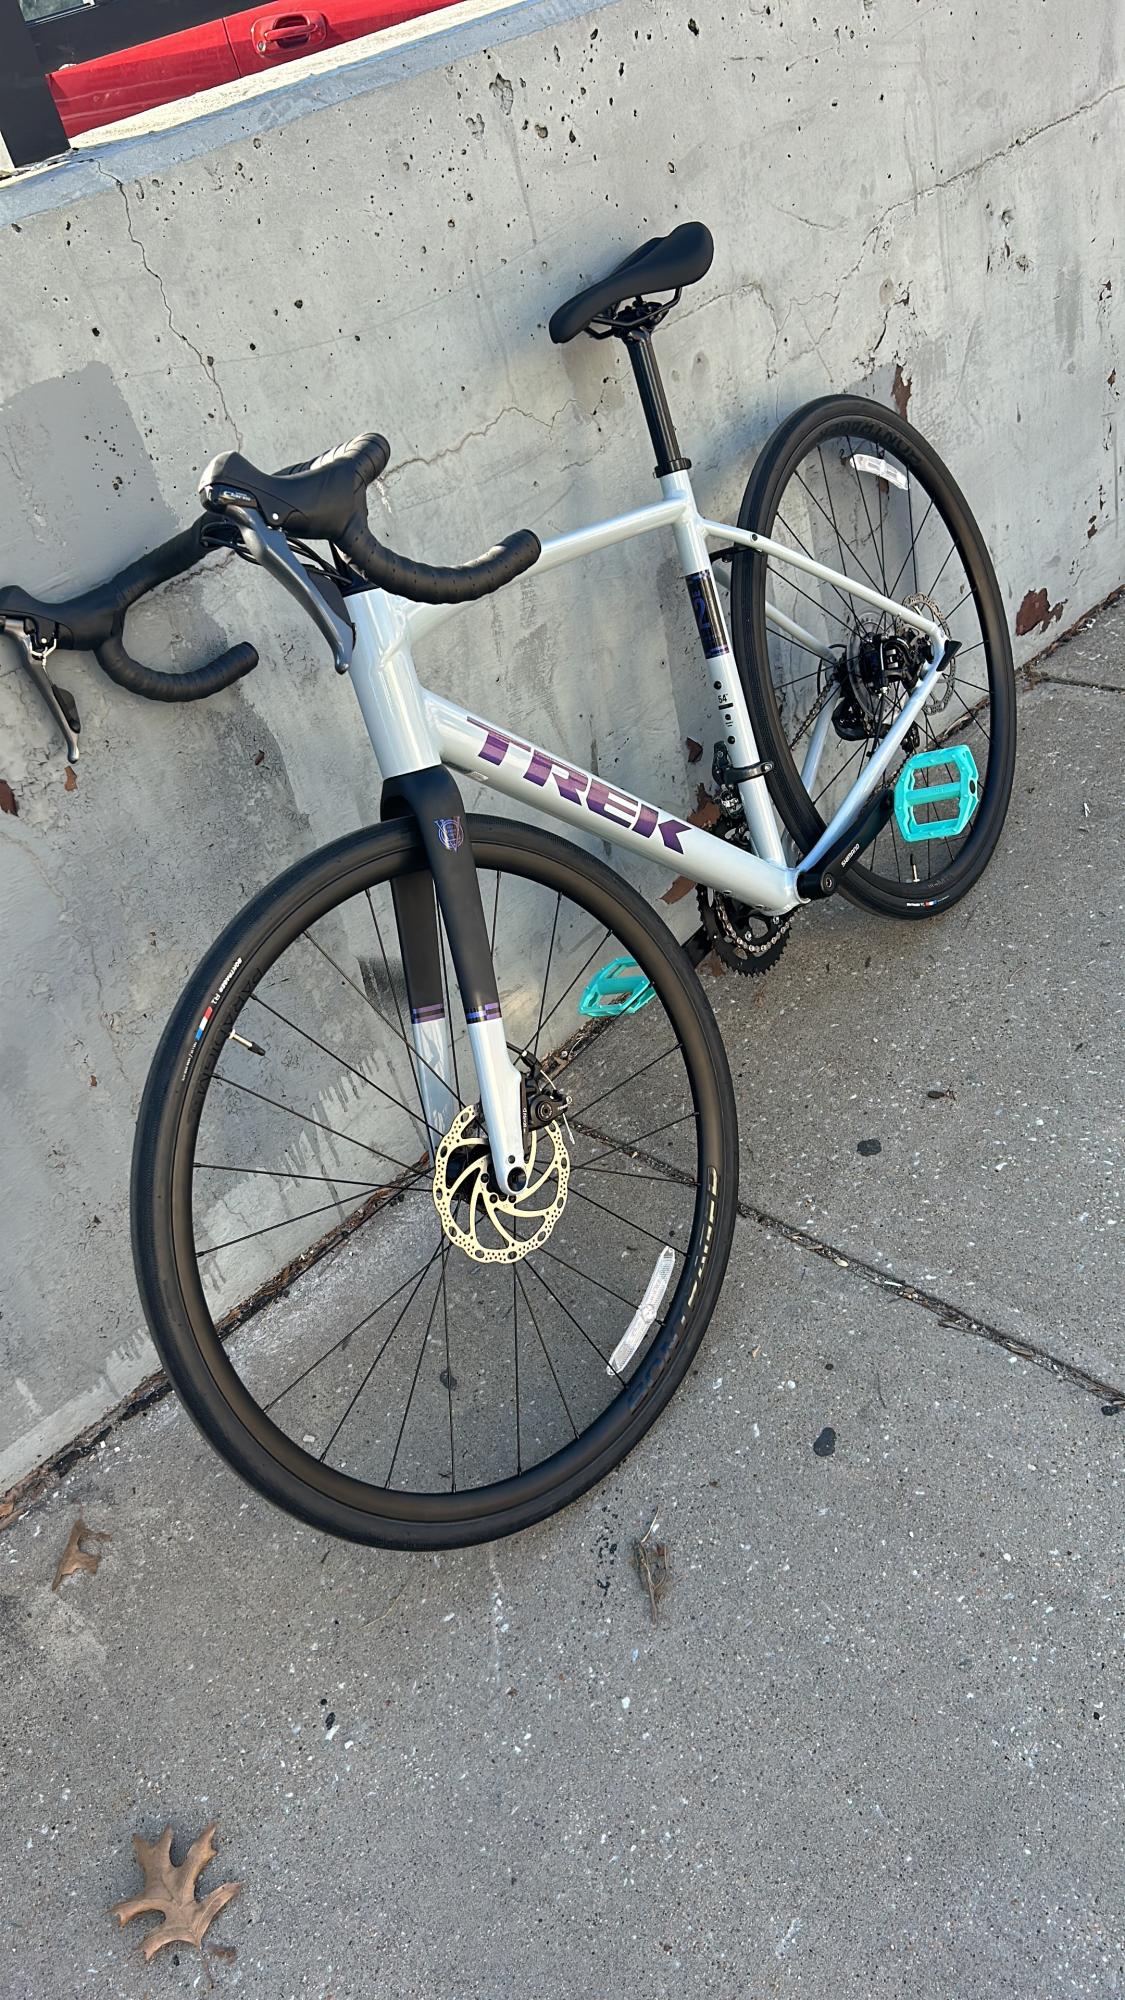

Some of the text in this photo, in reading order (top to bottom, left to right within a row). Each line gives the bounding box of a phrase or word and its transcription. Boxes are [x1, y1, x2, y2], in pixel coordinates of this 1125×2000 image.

[466, 716, 692, 855] TREK
[840, 843, 860, 868] SHIMANO
[218, 956, 243, 993] BONTRAGER
